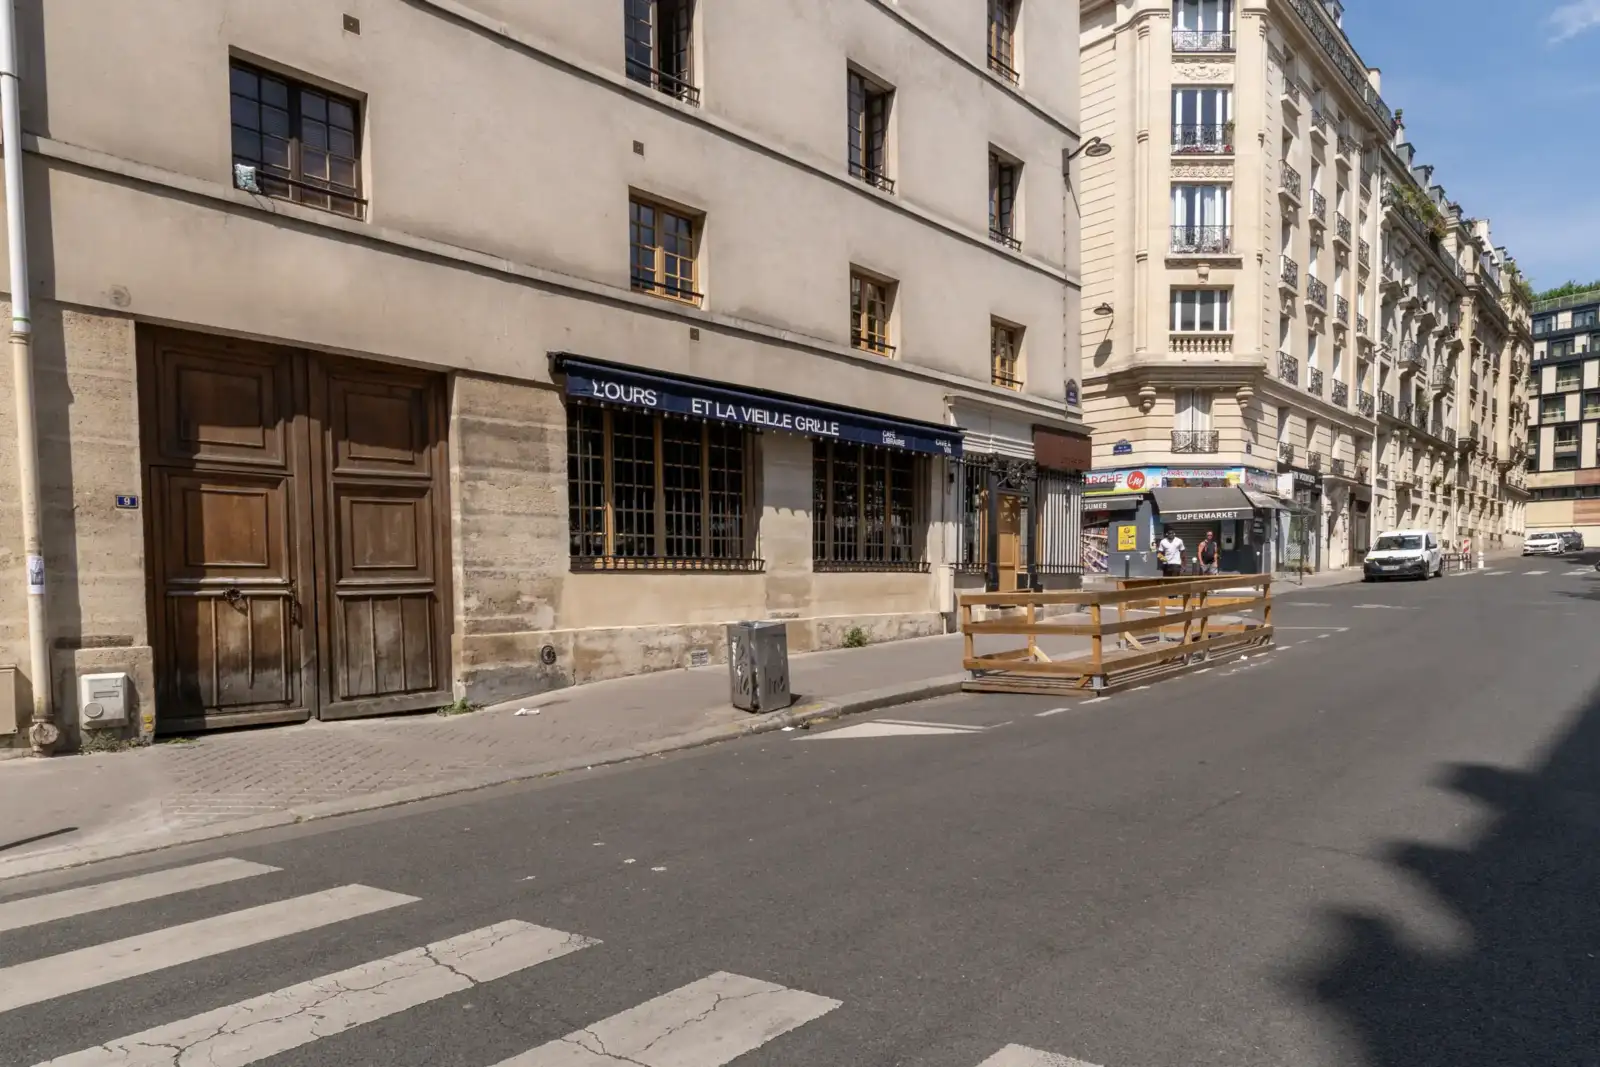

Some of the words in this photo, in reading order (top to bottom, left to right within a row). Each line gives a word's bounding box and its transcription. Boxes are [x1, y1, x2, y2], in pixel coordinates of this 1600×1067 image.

[592, 379, 657, 406] L'OURS
[692, 397, 713, 414] ET
[716, 401, 737, 420] LA
[741, 405, 792, 428] VIEILLE
[795, 415, 840, 436] GRILLE
[123, 496, 130, 505] 9
[1176, 511, 1239, 521] SUPERMARKET
